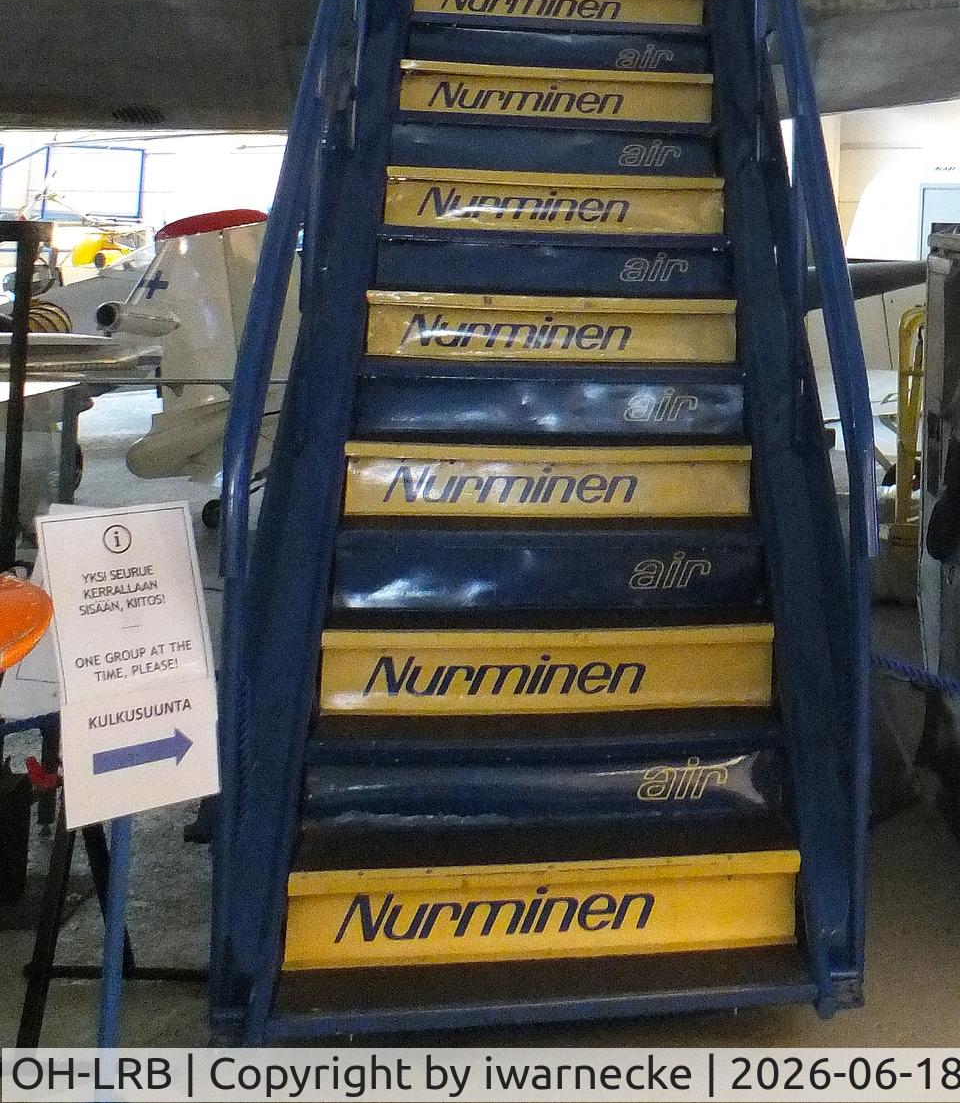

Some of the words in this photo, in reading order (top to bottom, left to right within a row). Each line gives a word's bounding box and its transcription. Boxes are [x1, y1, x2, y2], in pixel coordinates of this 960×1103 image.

[615, 44, 675, 70] air
[428, 81, 625, 115] Nurminen
[618, 139, 682, 167] air
[417, 185, 630, 223] Nurminen
[619, 251, 689, 282] air
[400, 313, 632, 351] Nurminen
[623, 387, 699, 422] air
[383, 465, 639, 504] Nurminen
[81, 571, 107, 584] YKSI
[110, 564, 154, 581] SEURUE
[629, 551, 712, 591] air
[79, 599, 124, 616] SISÄÄN,
[126, 593, 167, 609] KIITOS!
[83, 580, 159, 600] KERRALLAAN
[75, 655, 101, 669] ONE
[105, 647, 146, 664] GROUP
[150, 644, 165, 657] AT
[169, 639, 192, 652] THE
[95, 667, 128, 682] TIME,
[131, 657, 179, 676] PLEASE!
[362, 654, 647, 697] Nurminen
[88, 698, 192, 730] KULKUSUUNTA
[637, 757, 729, 801] air
[334, 886, 656, 944] Nurminen
